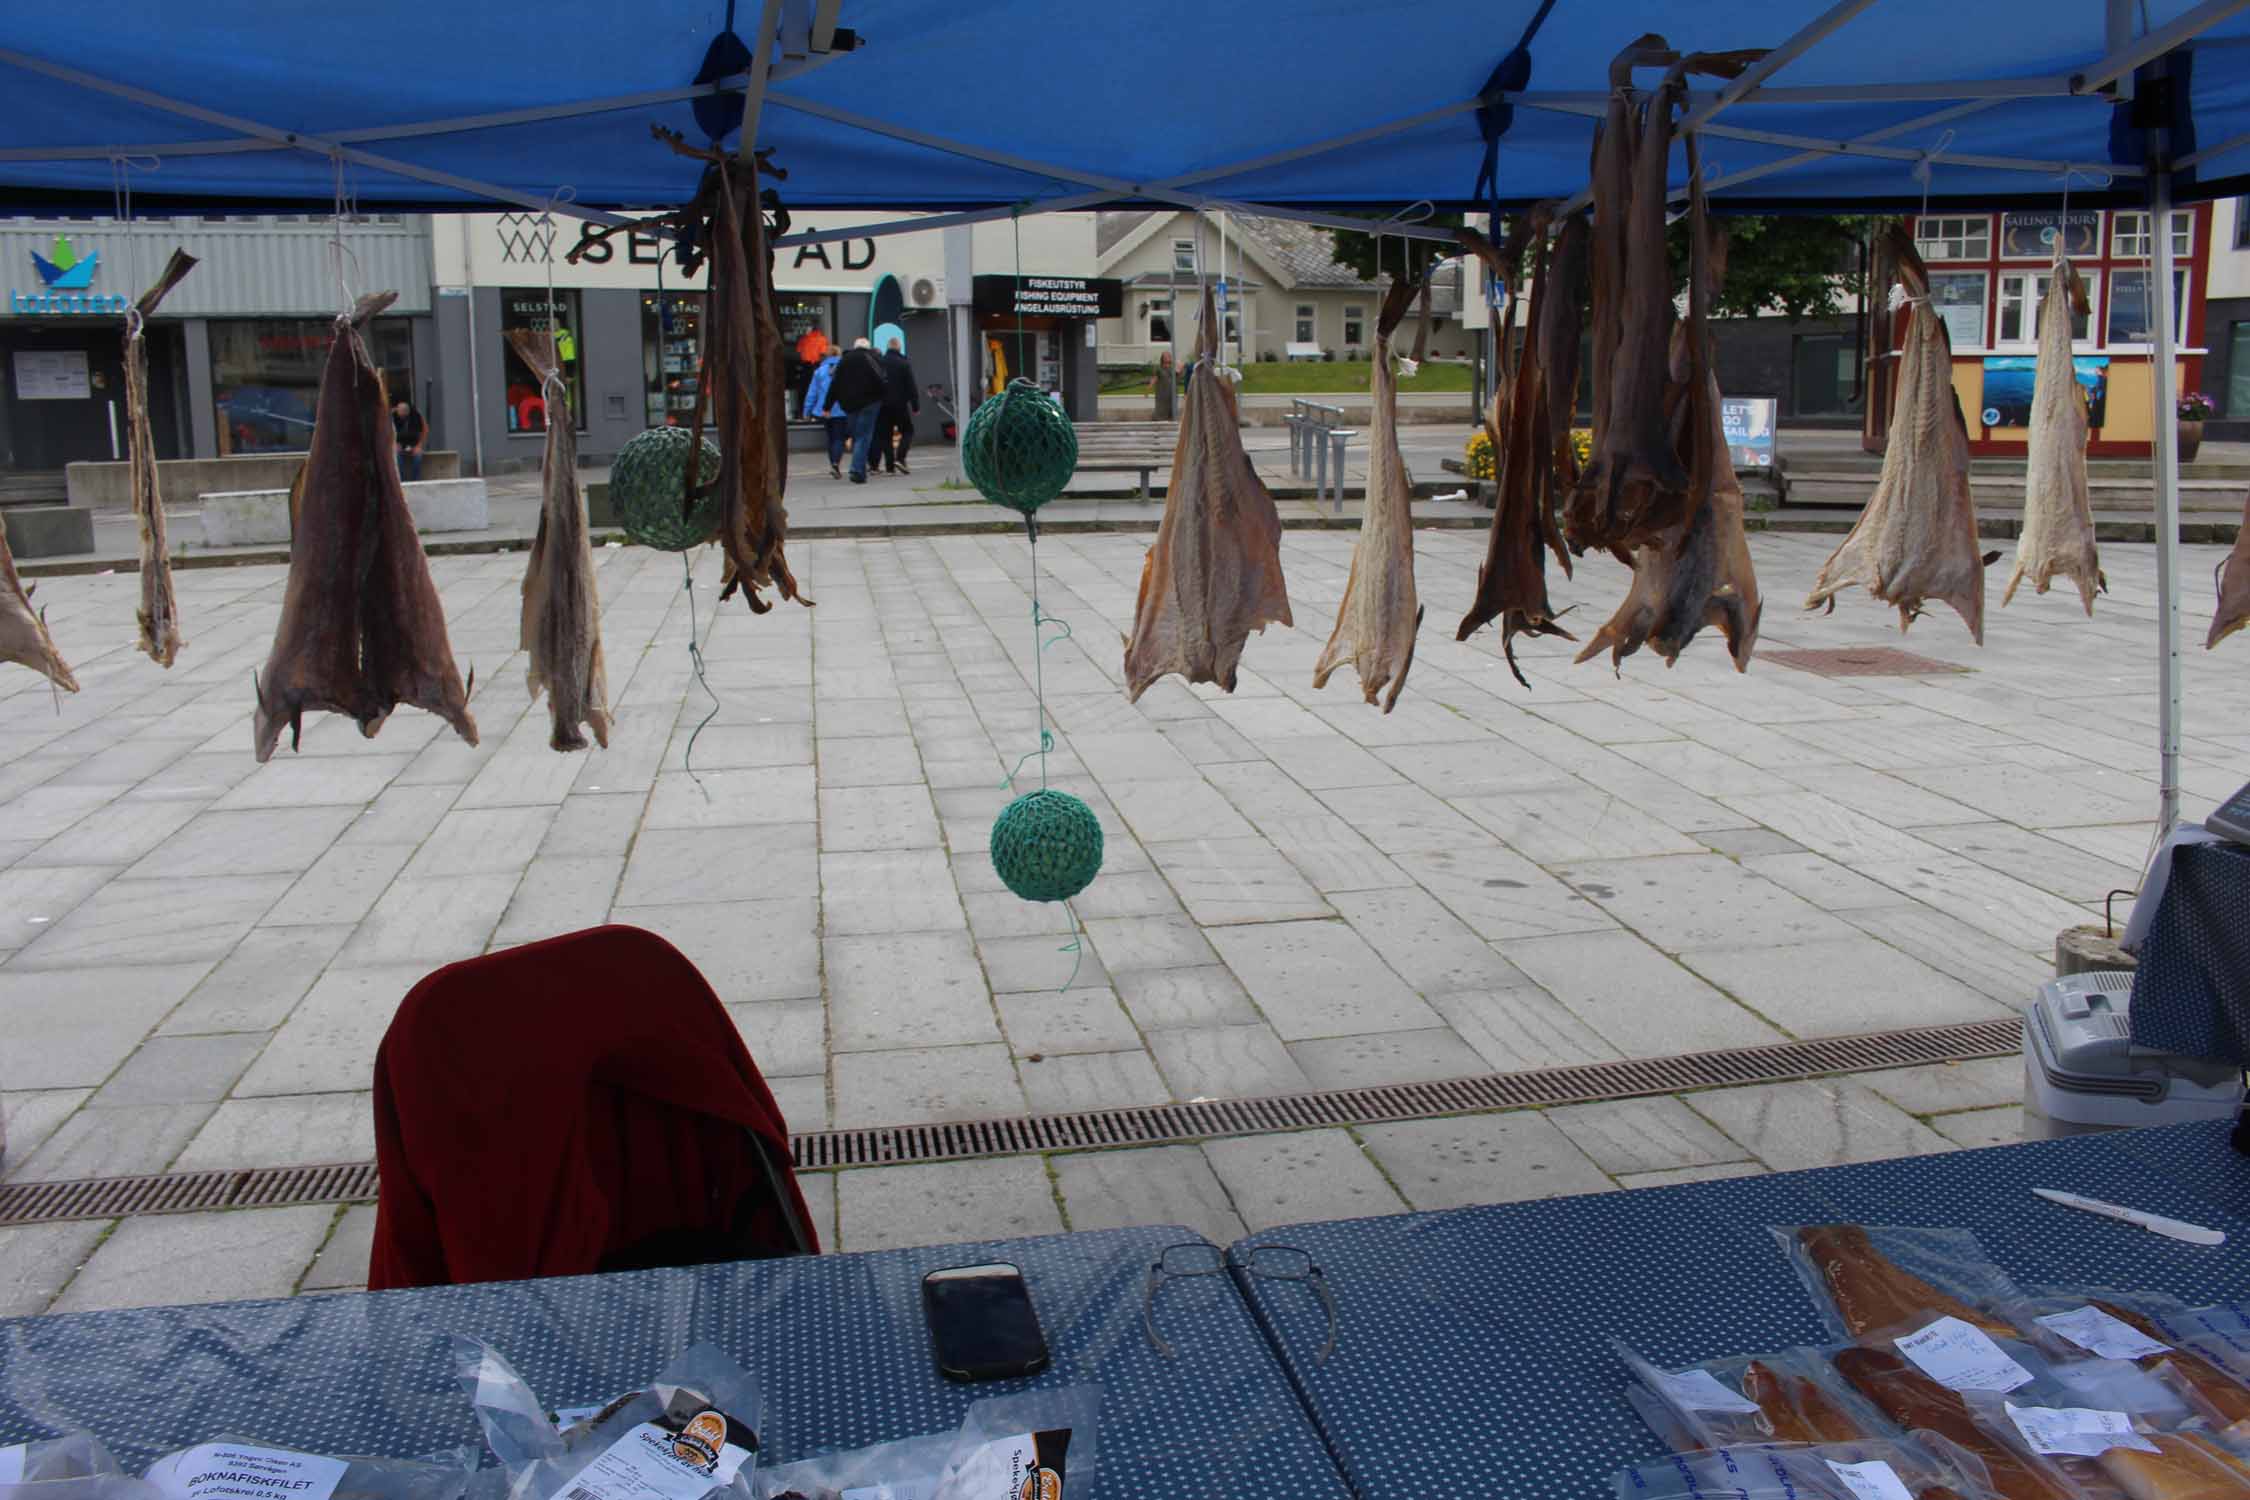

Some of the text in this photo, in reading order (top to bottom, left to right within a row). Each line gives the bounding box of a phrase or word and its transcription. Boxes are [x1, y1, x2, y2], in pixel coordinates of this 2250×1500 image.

[2006, 215, 2097, 226] SAILING TOURS
[1028, 279, 1086, 290] FISKEUTSTYR
[1015, 290, 1099, 303] FISHING EQUIPMENT
[513, 303, 567, 313] SELSTAD
[1014, 303, 1100, 314] ANGELAUSRÜSTUNG
[188, 1472, 313, 1490] BOKNAFISKFILET
